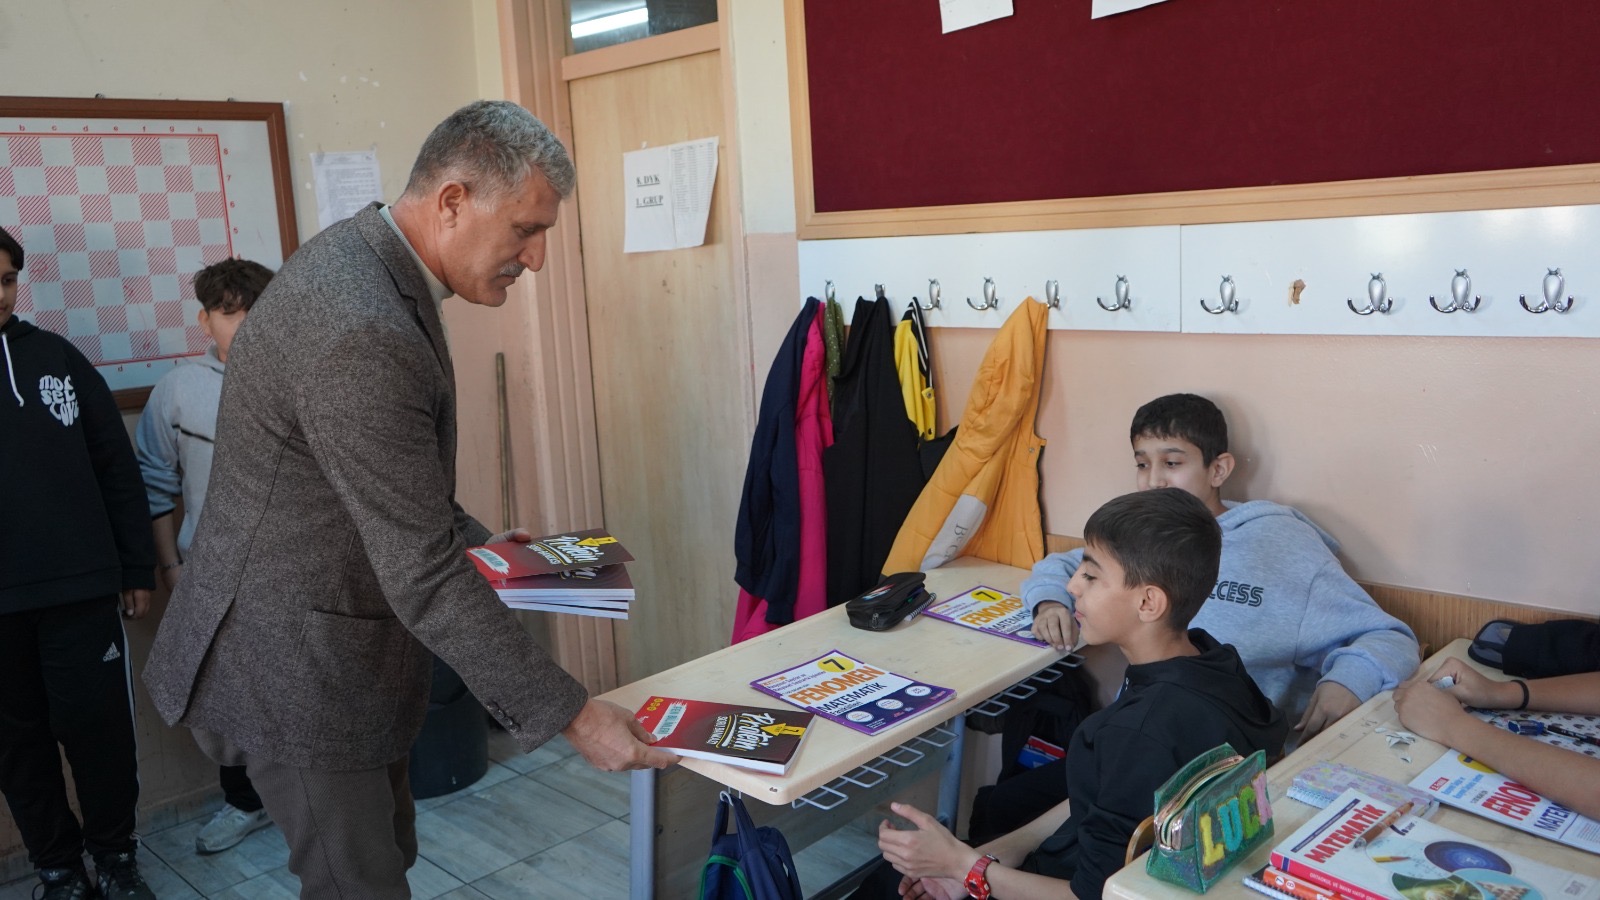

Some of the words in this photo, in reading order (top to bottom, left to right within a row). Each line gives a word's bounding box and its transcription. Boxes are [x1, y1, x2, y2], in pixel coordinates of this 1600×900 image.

[975, 591, 996, 600] 7
[1209, 580, 1264, 607] CESS
[822, 658, 845, 671] 7
[788, 666, 886, 705] FENOMEN
[815, 682, 888, 713] MATEMATİK
[733, 712, 776, 751] Protein
[1304, 803, 1388, 864] MATEMATİK
